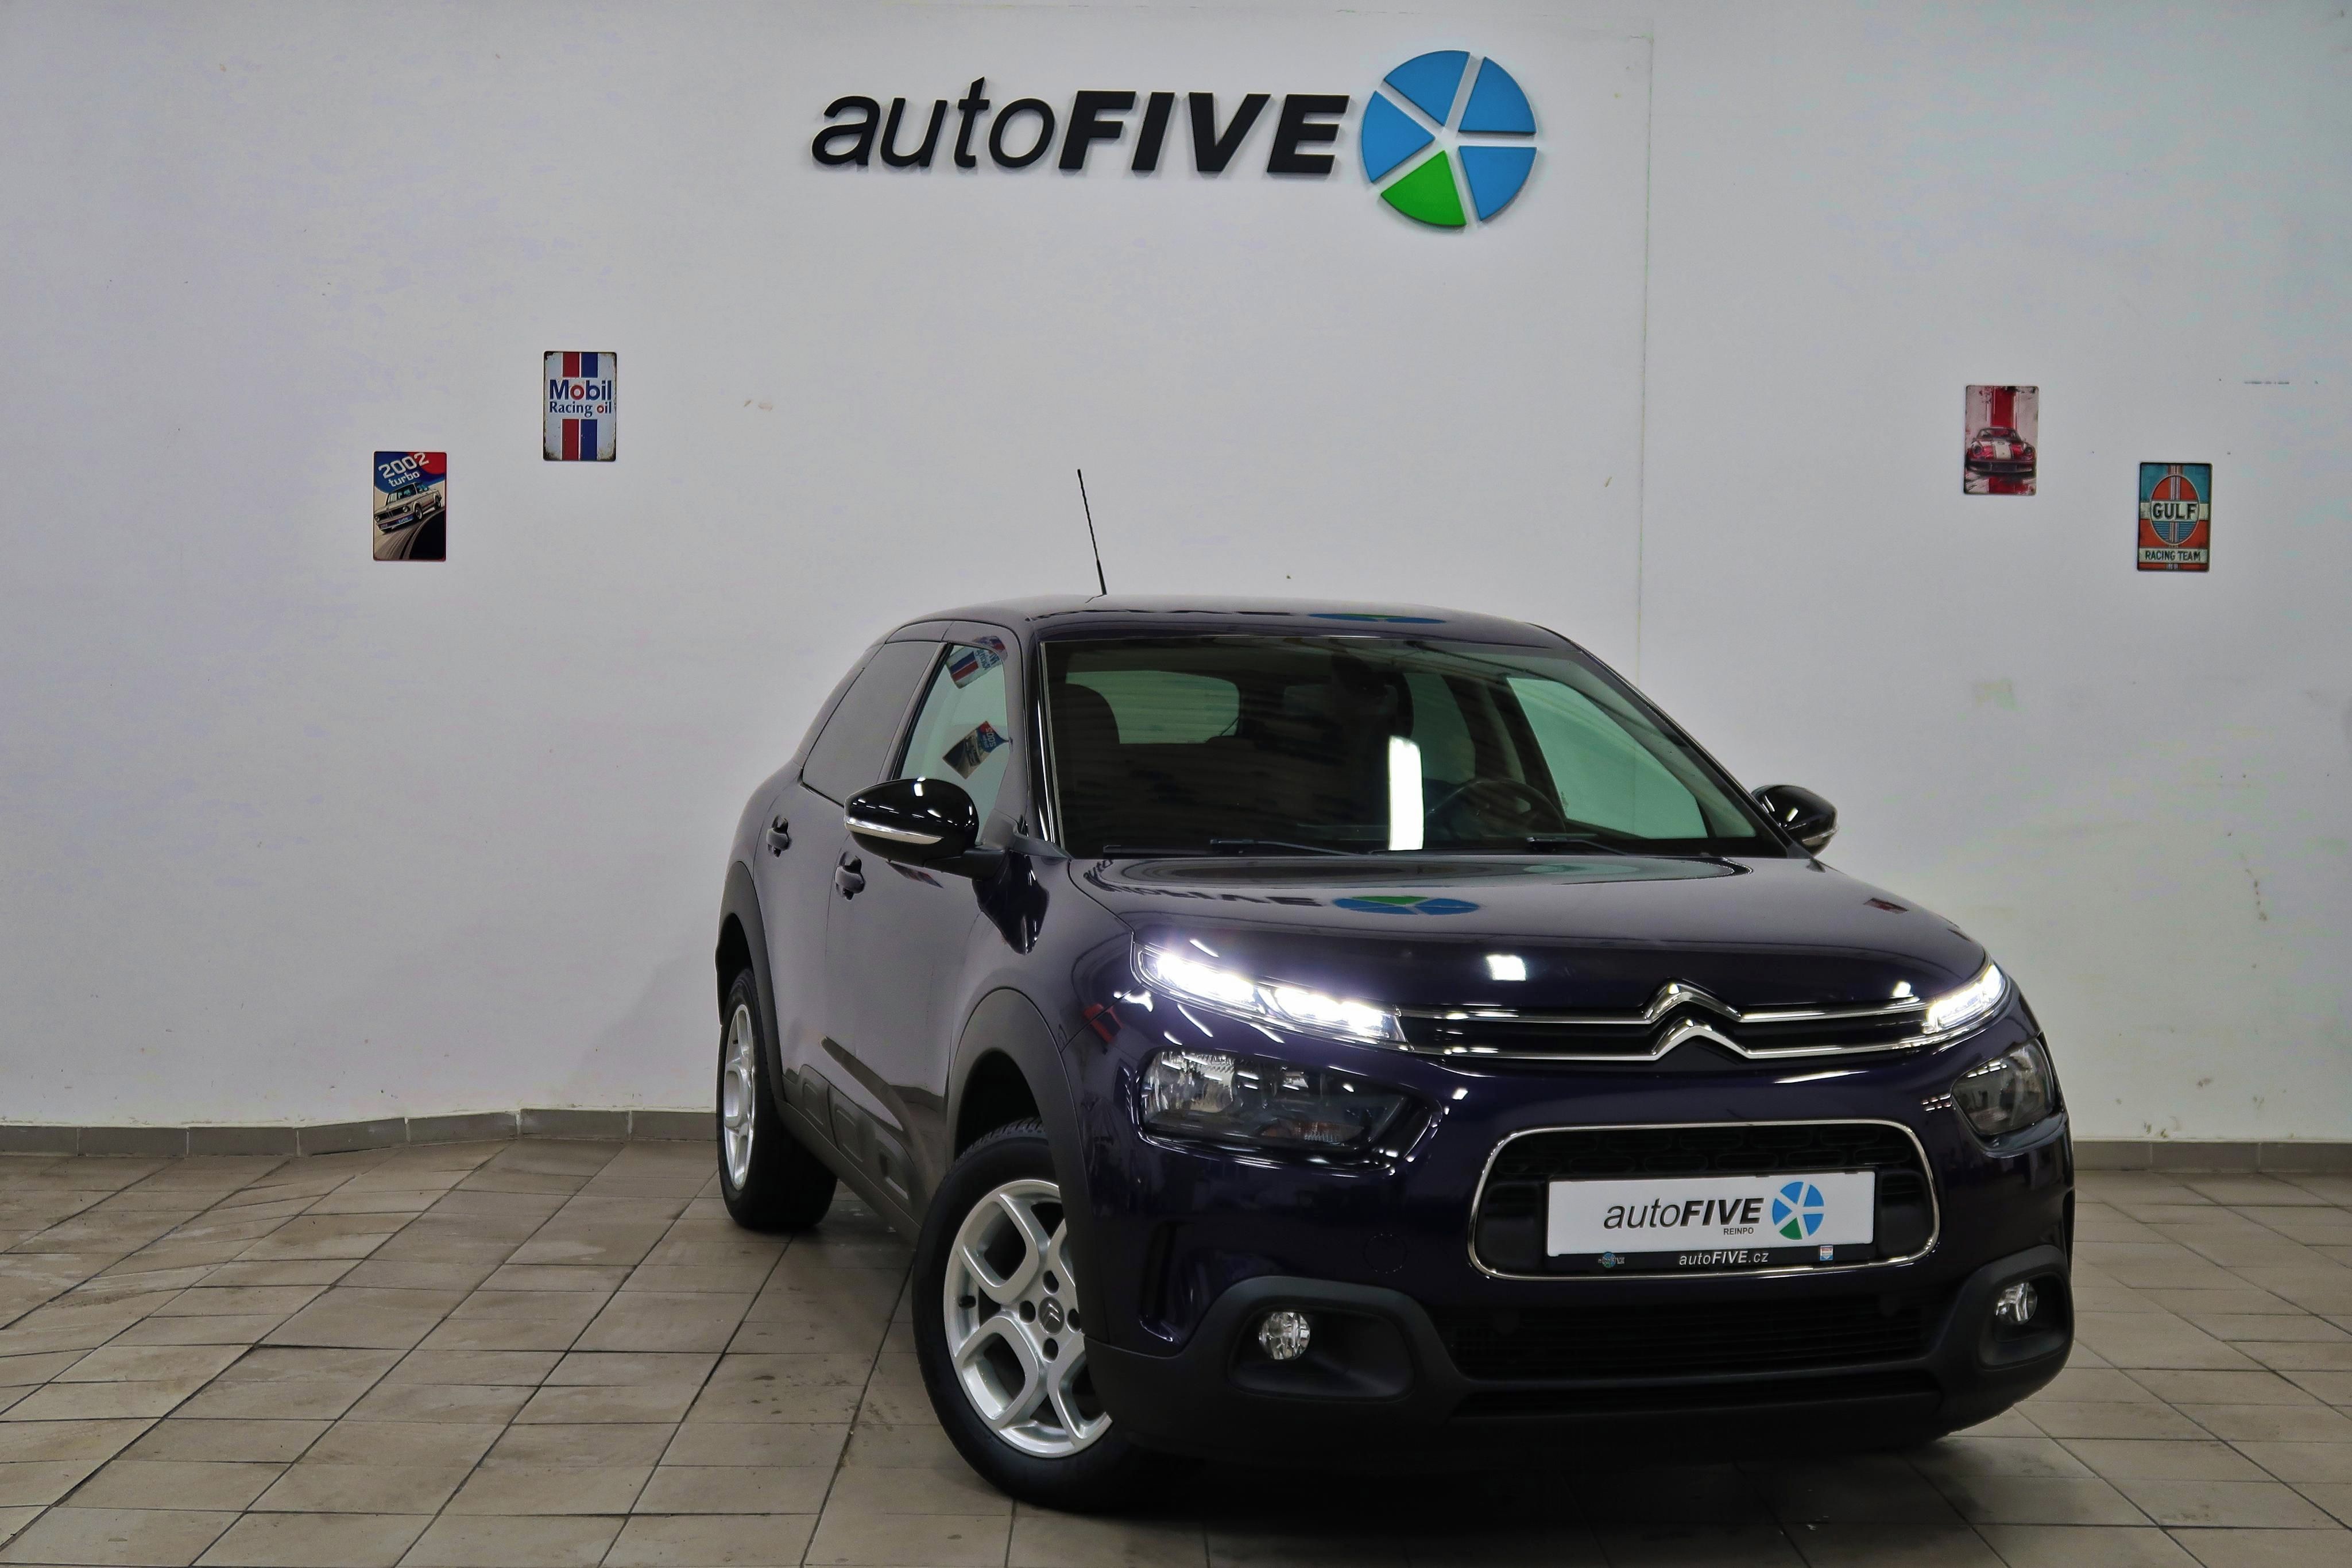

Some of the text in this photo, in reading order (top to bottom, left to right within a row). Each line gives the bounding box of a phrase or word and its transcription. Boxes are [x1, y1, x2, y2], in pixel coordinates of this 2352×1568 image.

[811, 77, 1349, 173] autoFIVE
[549, 380, 612, 401] Mobil
[549, 401, 612, 417] Racing oil
[378, 452, 429, 479] 2002
[388, 471, 420, 487] turbo
[2153, 503, 2197, 520] GULF
[2145, 551, 2200, 561] RACING TEAM
[1603, 1198, 1765, 1229] autoFIVE
[1723, 1227, 1754, 1235] REINPO
[1679, 1250, 1769, 1265] autoFIVE.cz
